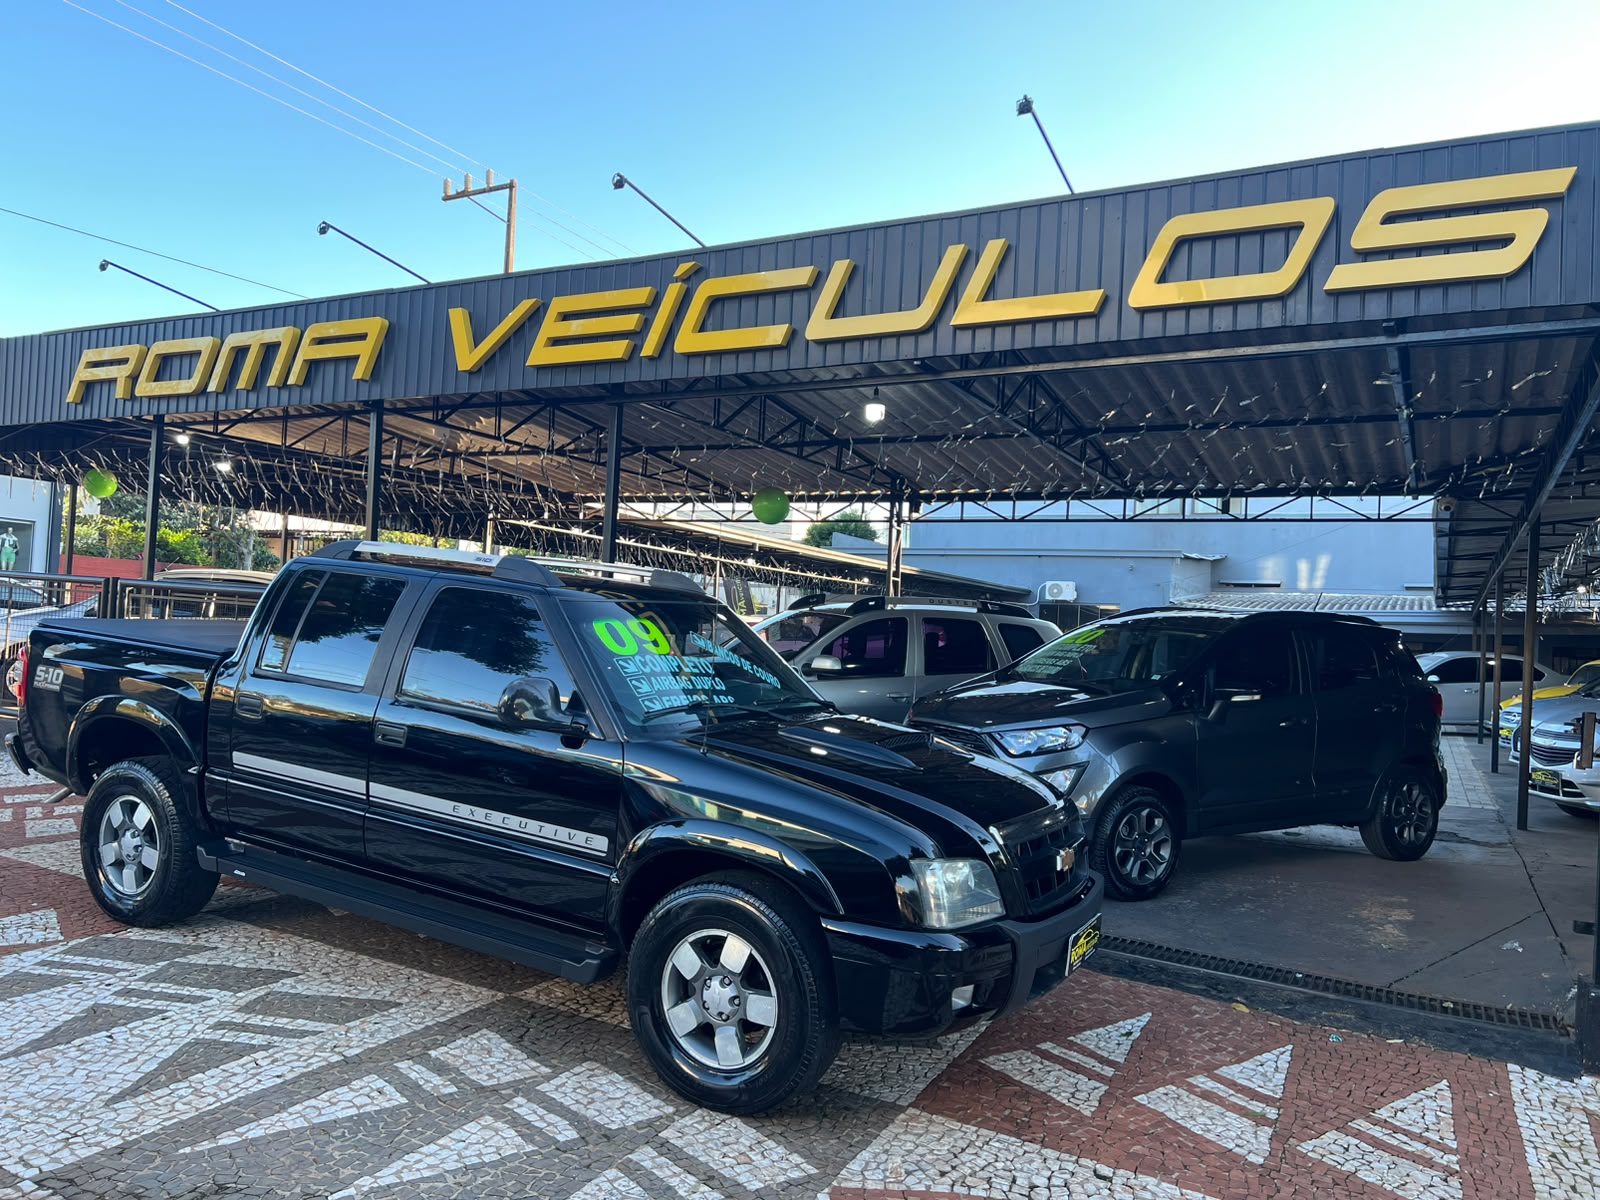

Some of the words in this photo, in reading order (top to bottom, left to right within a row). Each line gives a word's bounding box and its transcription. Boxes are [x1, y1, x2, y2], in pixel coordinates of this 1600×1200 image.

[66, 316, 389, 404] ROMA
[448, 166, 1578, 373] VEÍCULOS
[592, 617, 671, 656] 09
[1061, 628, 1106, 644] 20
[634, 655, 715, 675] COMPLETO
[740, 656, 754, 674] DE
[752, 664, 781, 689] COURO
[650, 675, 693, 691] AIRBAG
[689, 675, 727, 691] DUPLO
[452, 804, 595, 846] EXECUTIVE
